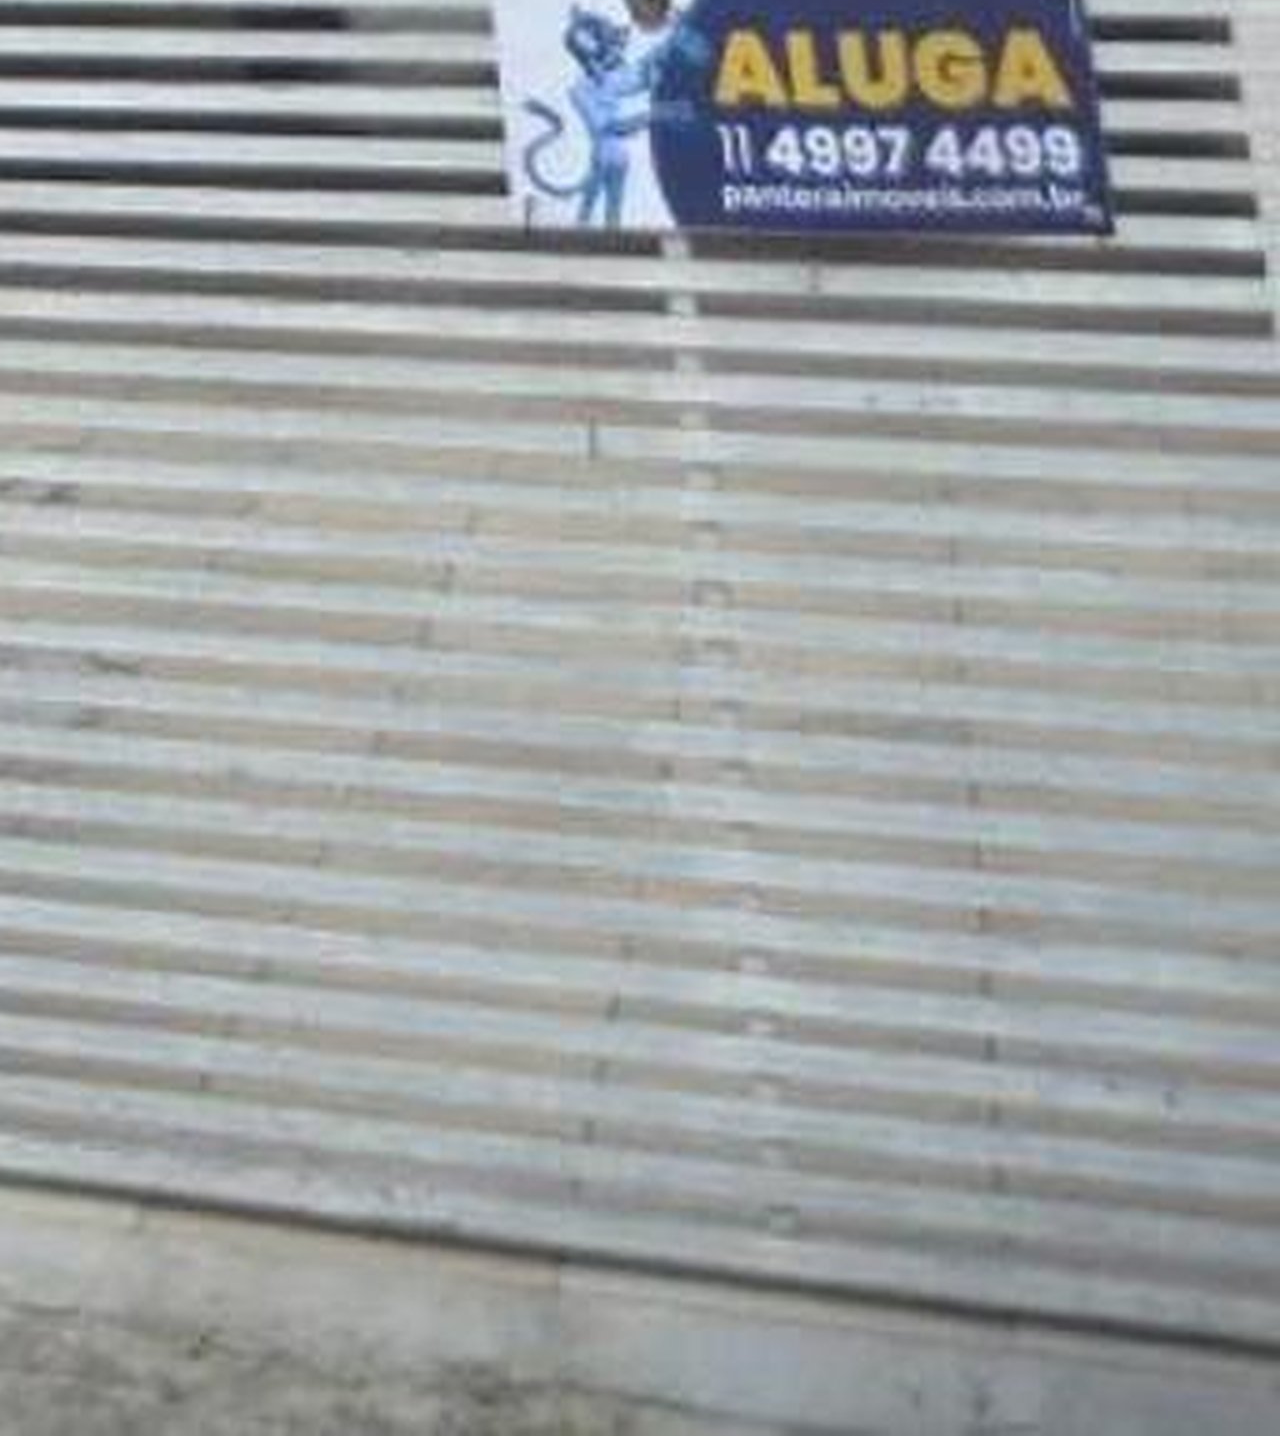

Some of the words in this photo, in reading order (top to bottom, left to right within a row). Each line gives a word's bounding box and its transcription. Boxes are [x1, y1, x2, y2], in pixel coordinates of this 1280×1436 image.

[714, 28, 1075, 111] ALUGA
[717, 124, 753, 176] 11
[766, 125, 911, 177] 4997
[925, 125, 1083, 177] 4499
